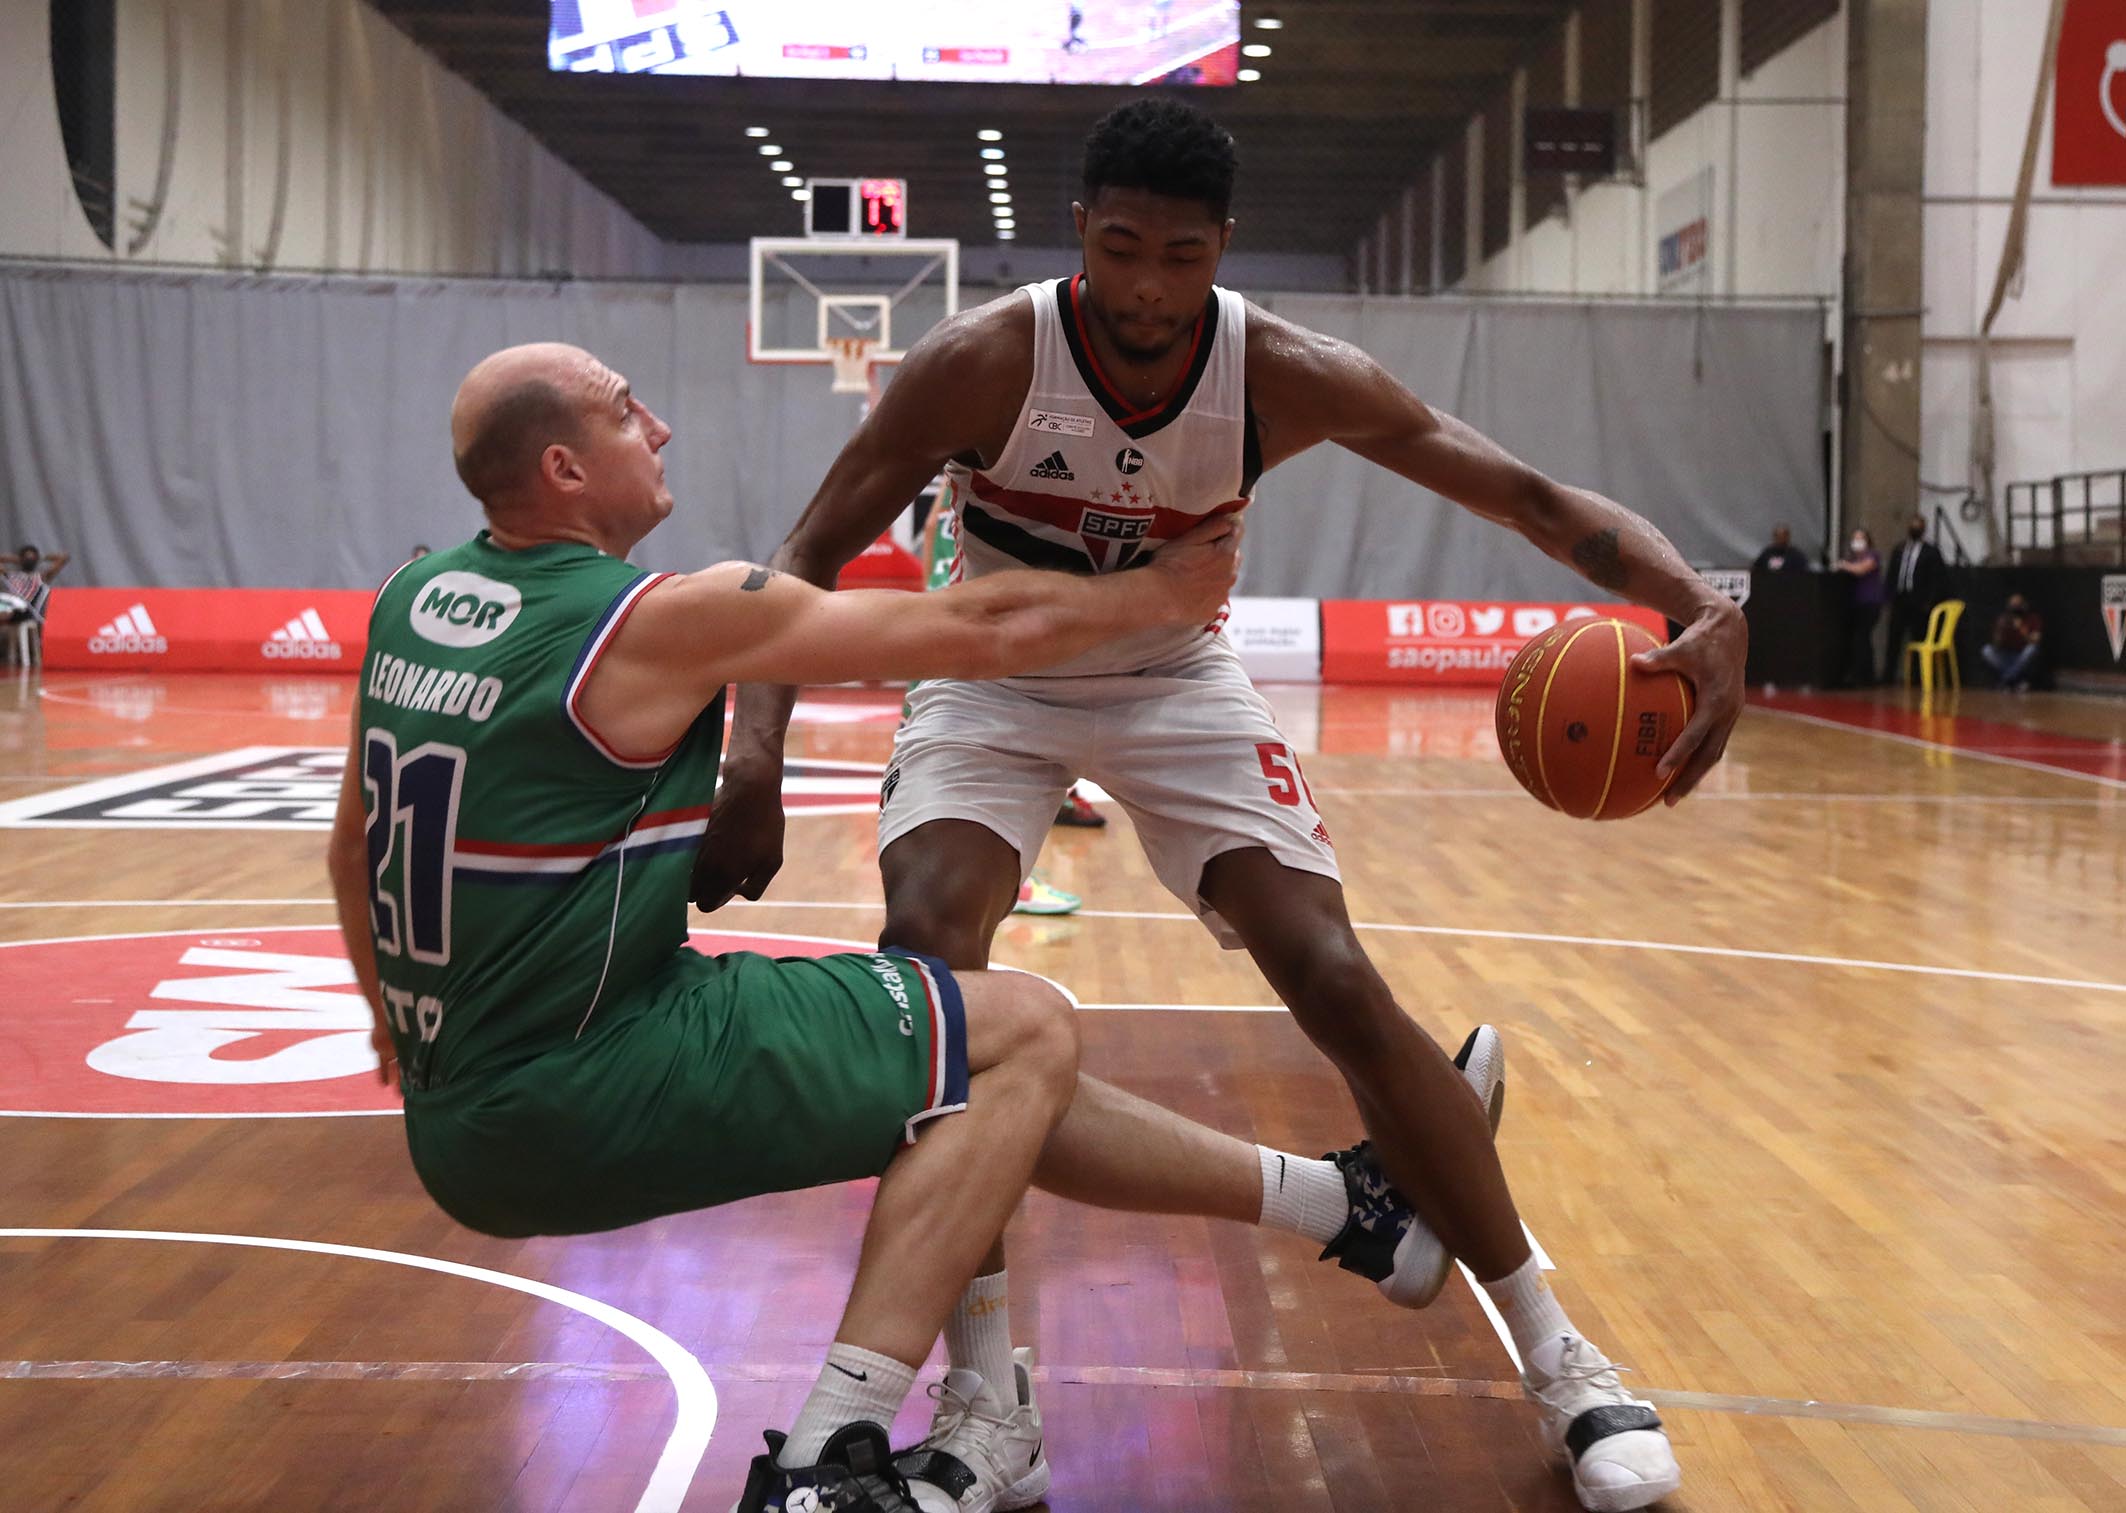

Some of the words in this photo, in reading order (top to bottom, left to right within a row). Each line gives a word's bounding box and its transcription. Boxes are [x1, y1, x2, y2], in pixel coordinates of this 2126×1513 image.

[1030, 467, 1075, 481] adidas
[1085, 515, 1151, 537] SPFC
[420, 587, 505, 630] MOR
[87, 635, 168, 654] adidas
[261, 640, 341, 660] adidas
[368, 651, 503, 722] LEONARDO
[1636, 711, 1658, 757] FIBA
